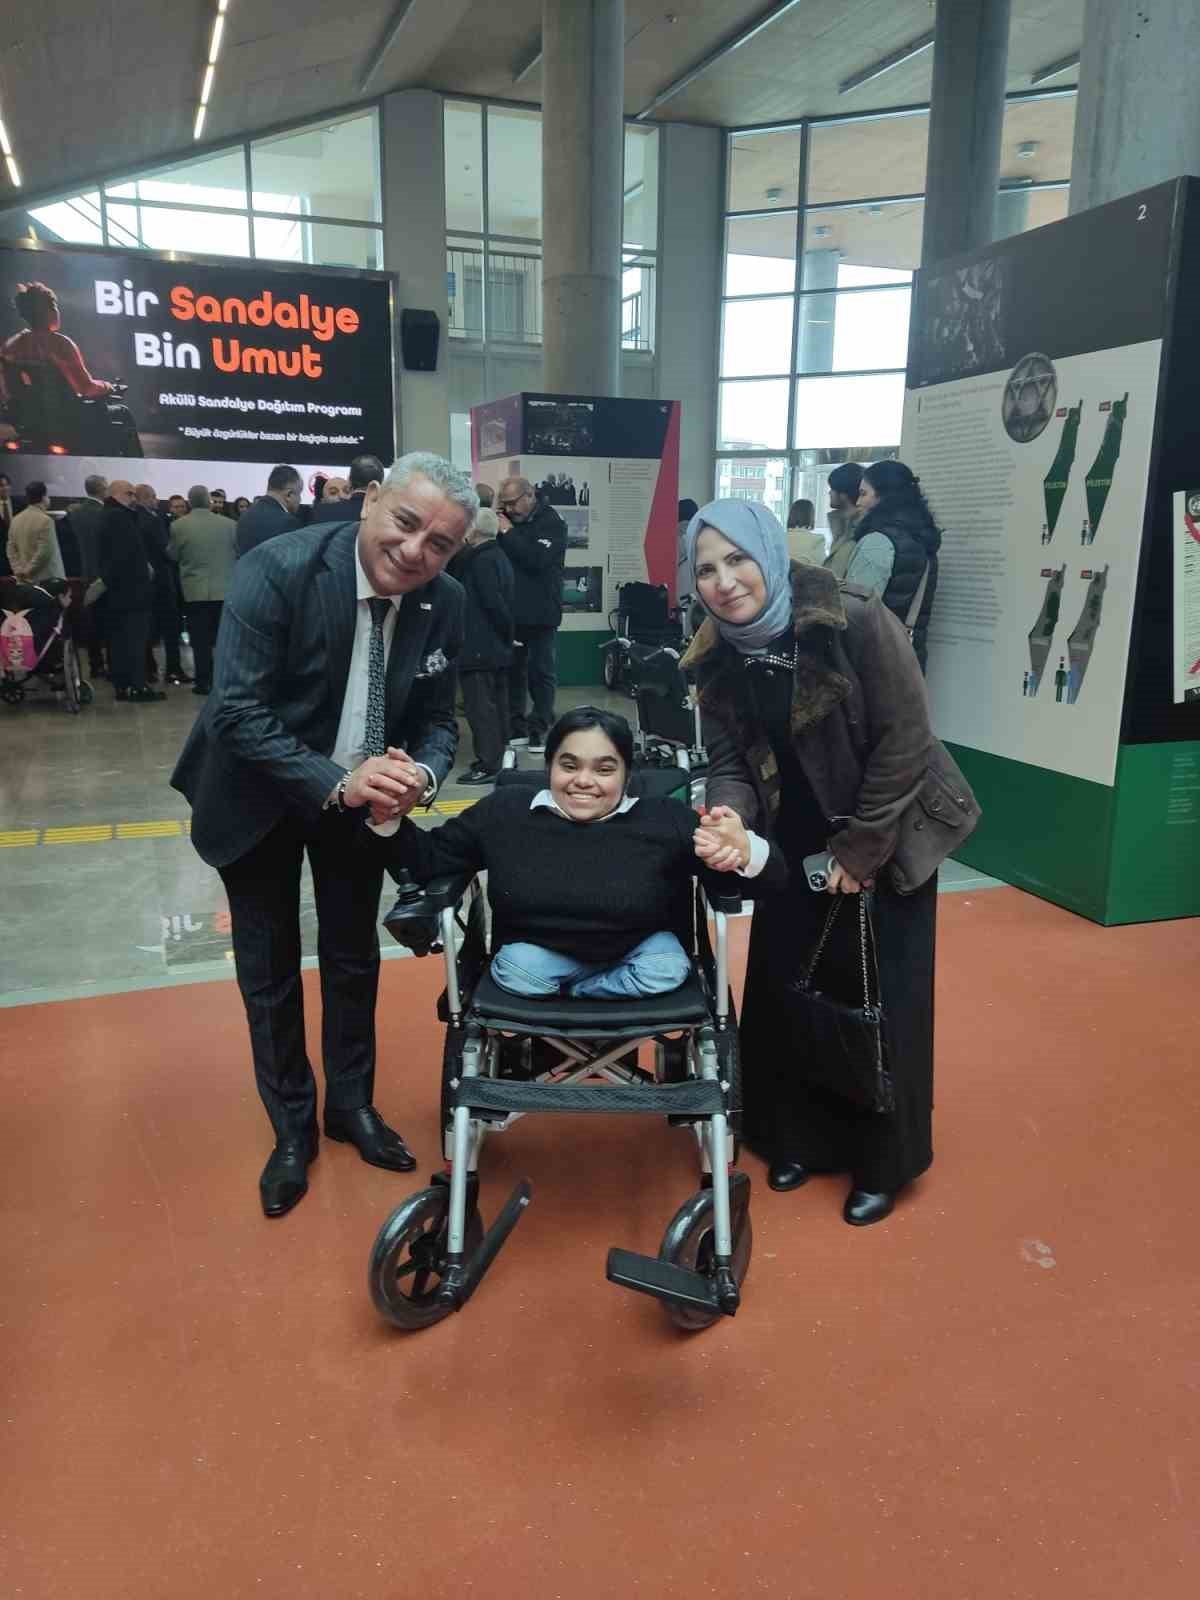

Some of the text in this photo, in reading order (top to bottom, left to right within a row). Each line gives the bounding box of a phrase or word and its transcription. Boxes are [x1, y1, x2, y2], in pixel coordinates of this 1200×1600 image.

[1136, 204, 1147, 221] 2
[93, 279, 361, 343] Bir Sandalye
[134, 332, 324, 379] Bin Umut
[158, 392, 362, 418] Akülü Sandalye Dağıtım Programı
